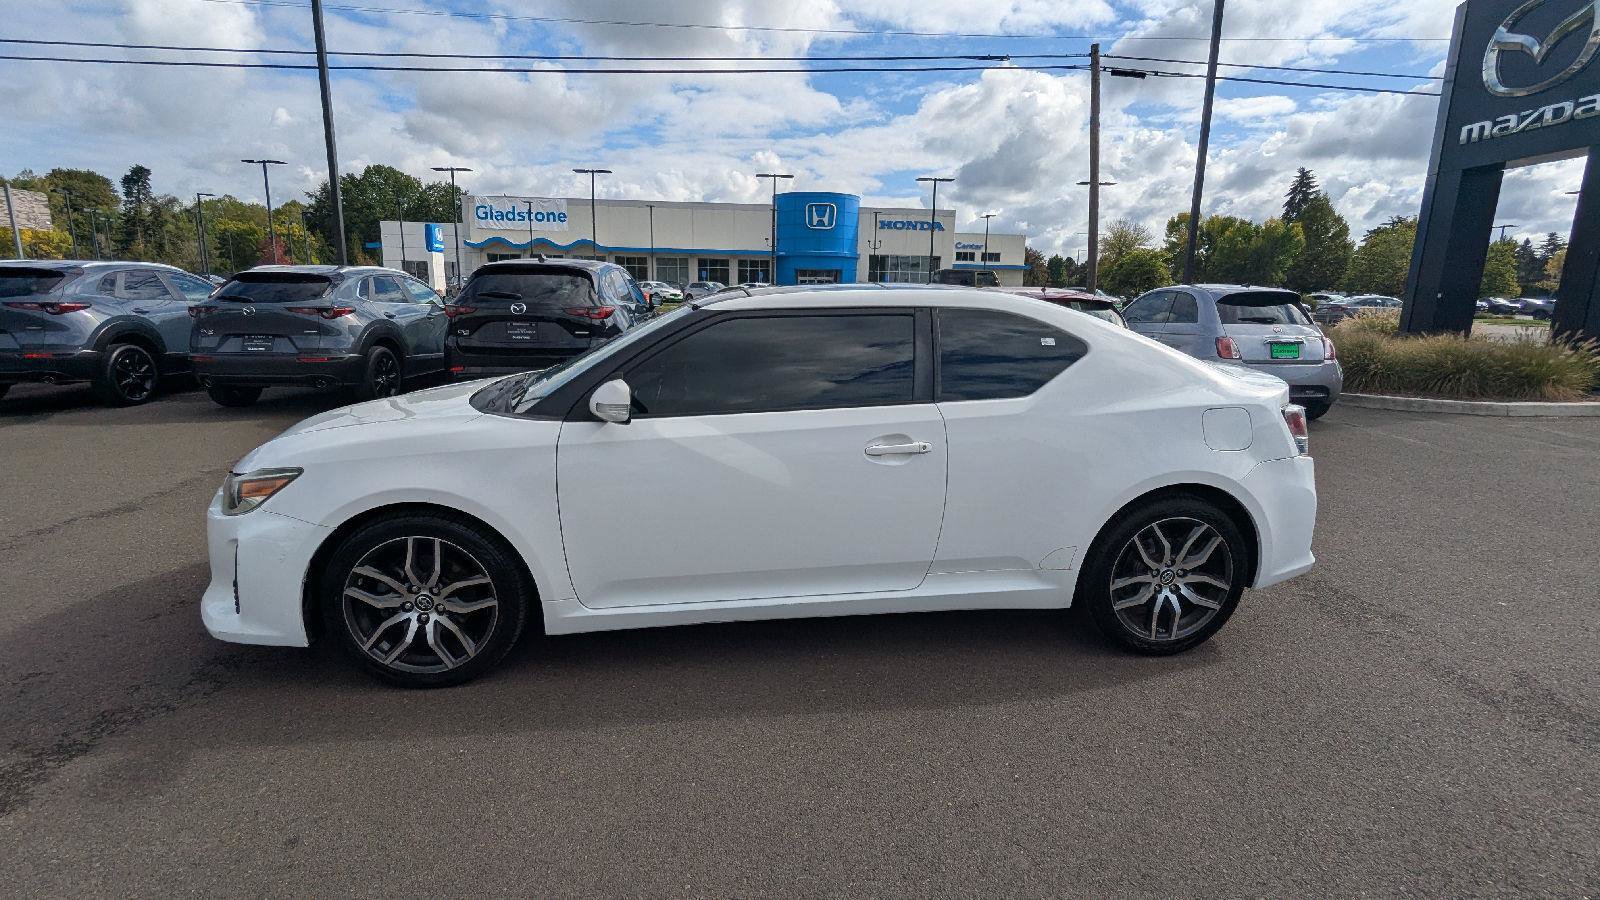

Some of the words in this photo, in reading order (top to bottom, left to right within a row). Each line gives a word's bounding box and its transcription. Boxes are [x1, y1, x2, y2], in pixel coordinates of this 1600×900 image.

[475, 204, 568, 223] Gladstone
[879, 220, 946, 232] HONDA
[955, 242, 984, 251] Center
